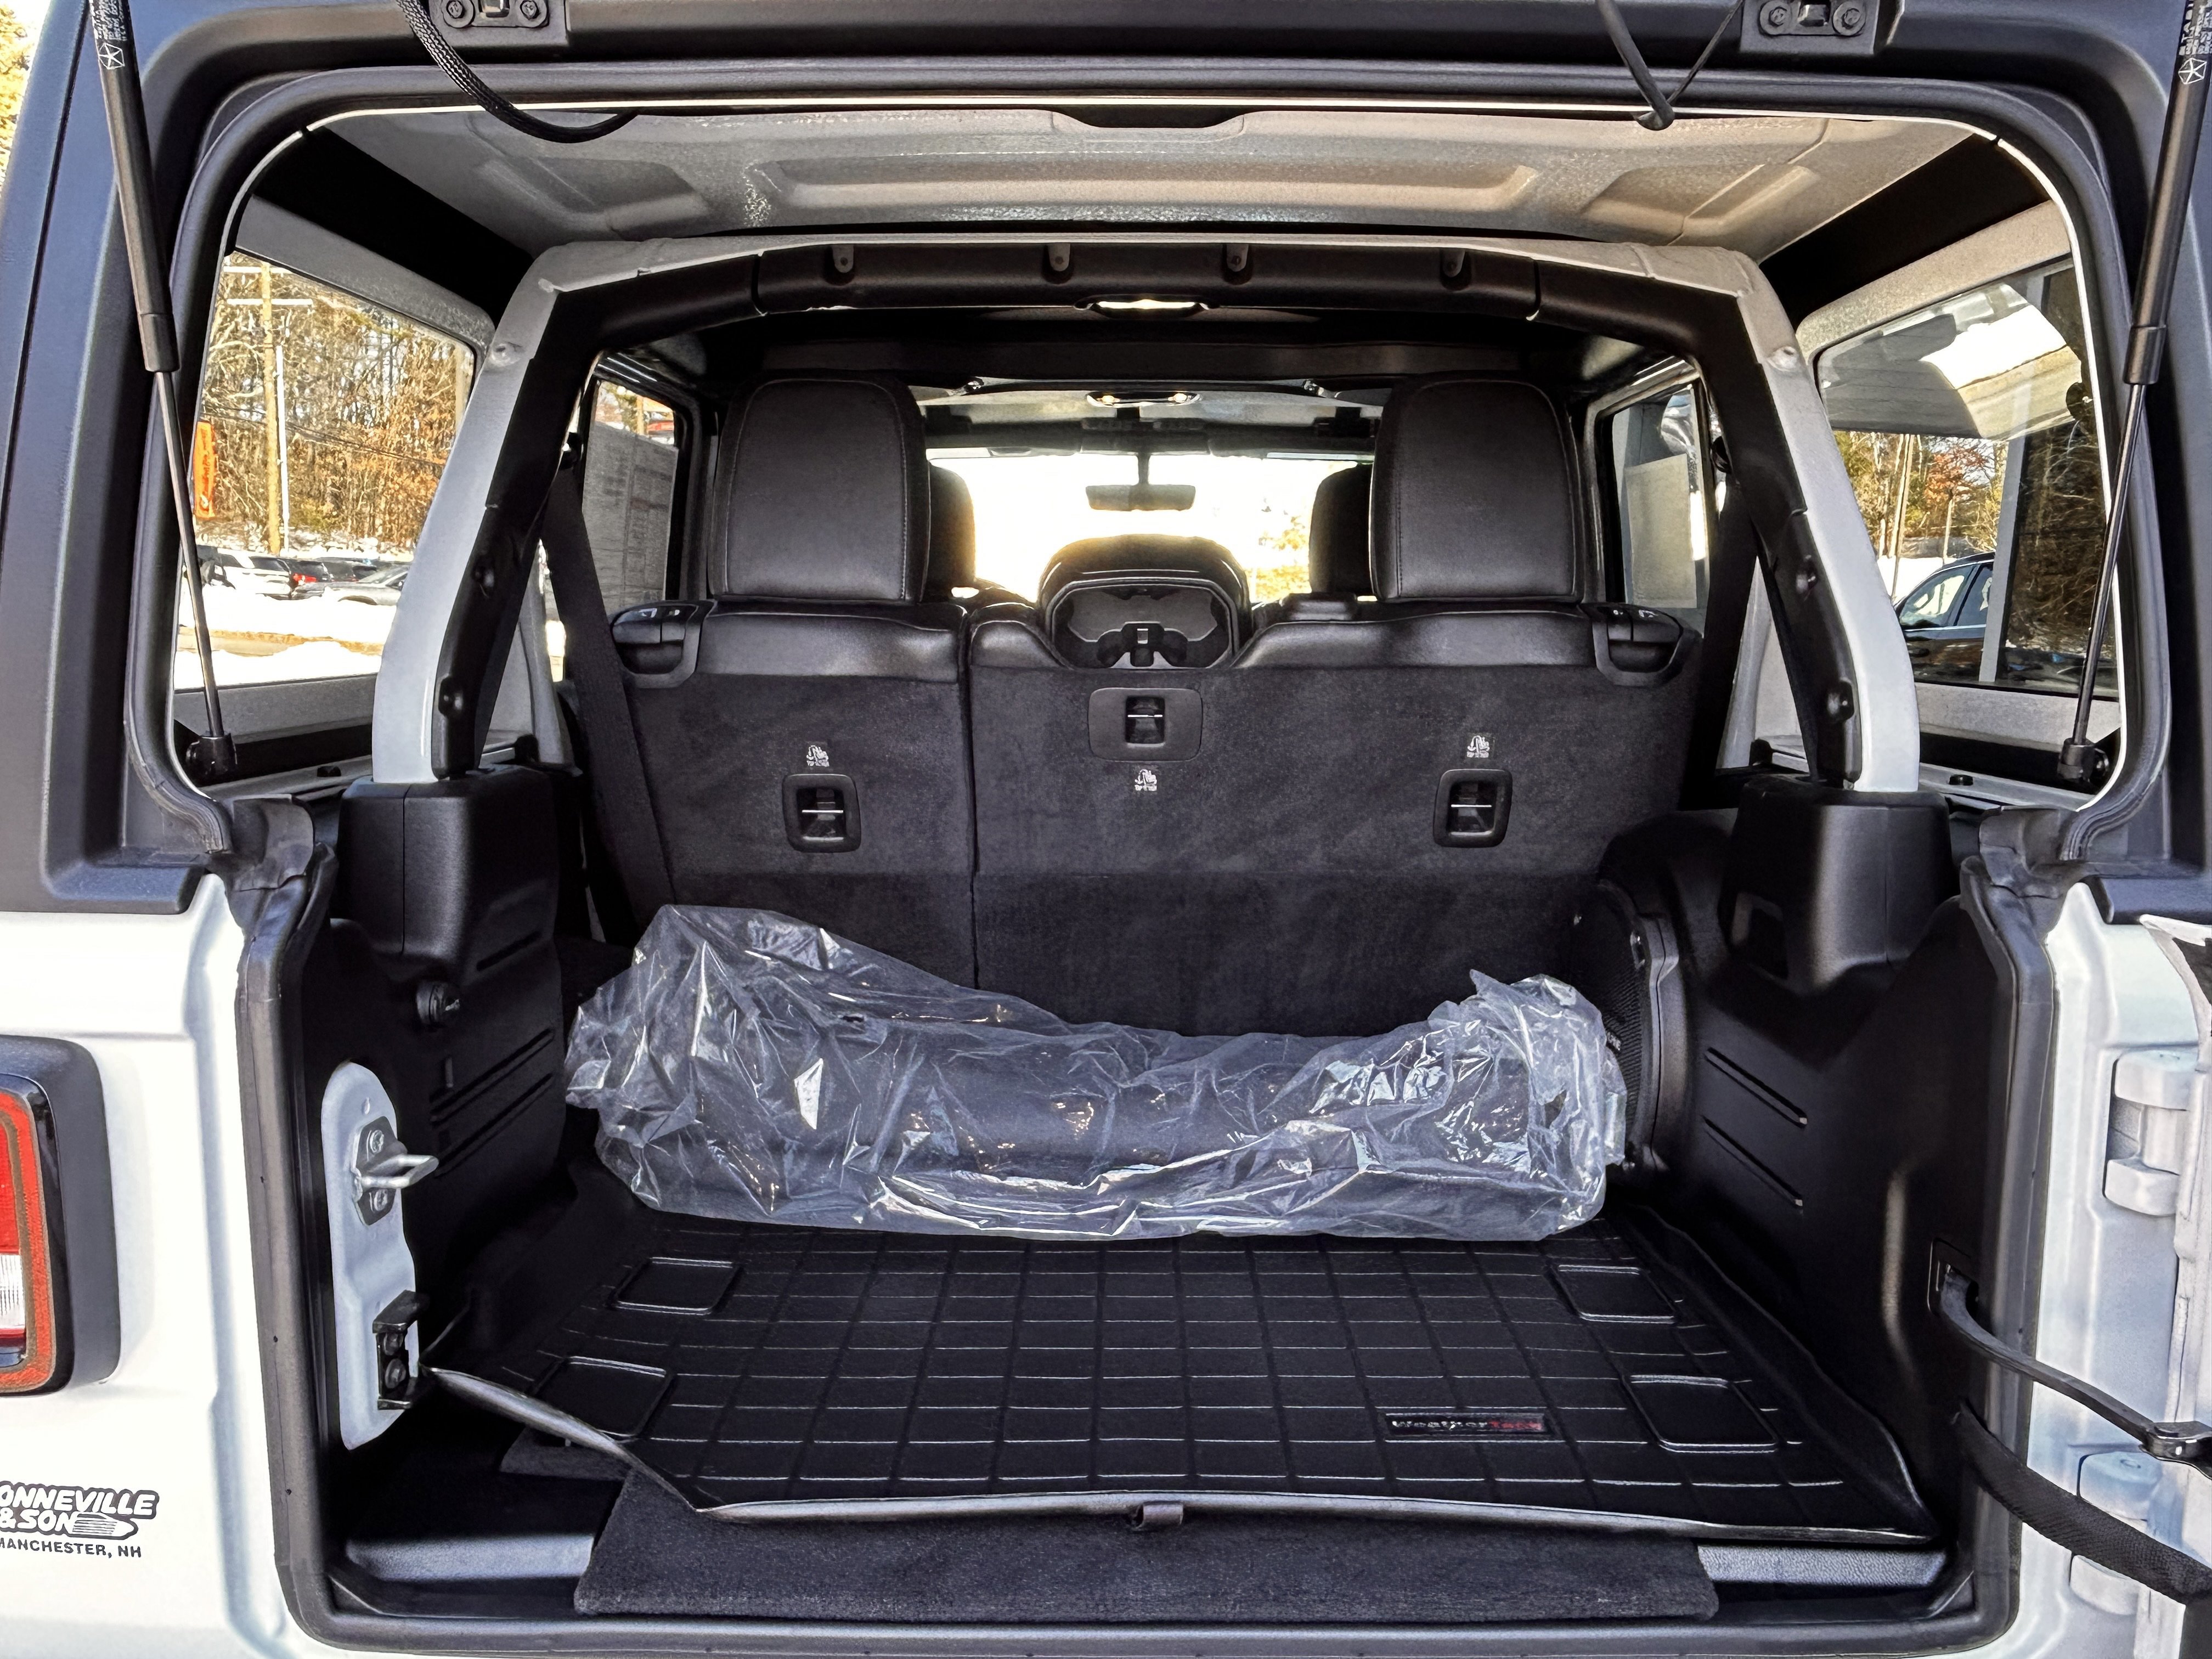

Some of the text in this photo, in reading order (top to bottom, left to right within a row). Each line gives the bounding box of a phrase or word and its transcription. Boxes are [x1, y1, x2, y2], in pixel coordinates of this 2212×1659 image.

[0, 1483, 156, 1515] ONNEVILLE
[17, 1509, 76, 1534] SON
[118, 1545, 142, 1558] NH
